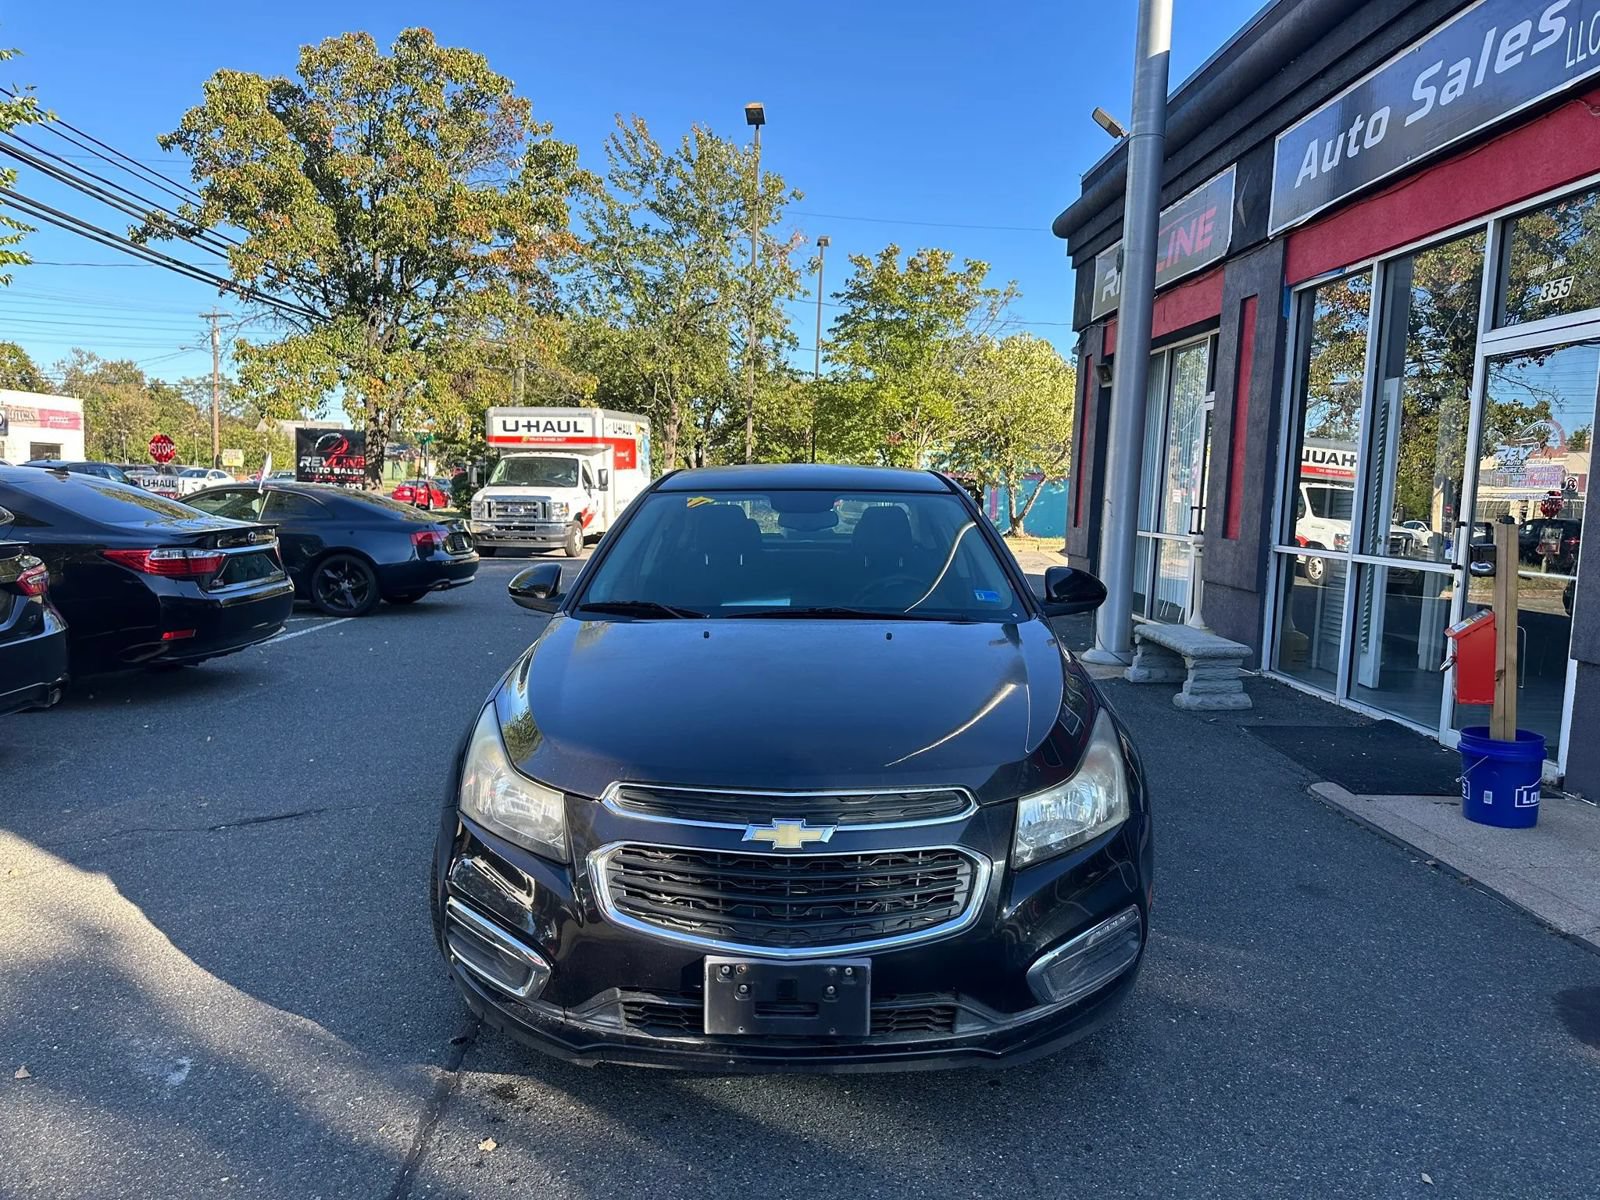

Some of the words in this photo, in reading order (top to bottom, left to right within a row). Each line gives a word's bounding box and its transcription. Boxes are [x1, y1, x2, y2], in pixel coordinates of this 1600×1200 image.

[1295, 106, 1390, 189] Auto
[1404, 0, 1572, 127] Sales
[1565, 10, 1600, 69] LLC
[1541, 278, 1572, 300] 355
[502, 420, 585, 433] U-HAUL
[150, 443, 174, 456] STOP
[299, 455, 365, 468] REVLINE
[334, 467, 365, 475] SALES
[142, 479, 177, 488] U-HAUL
